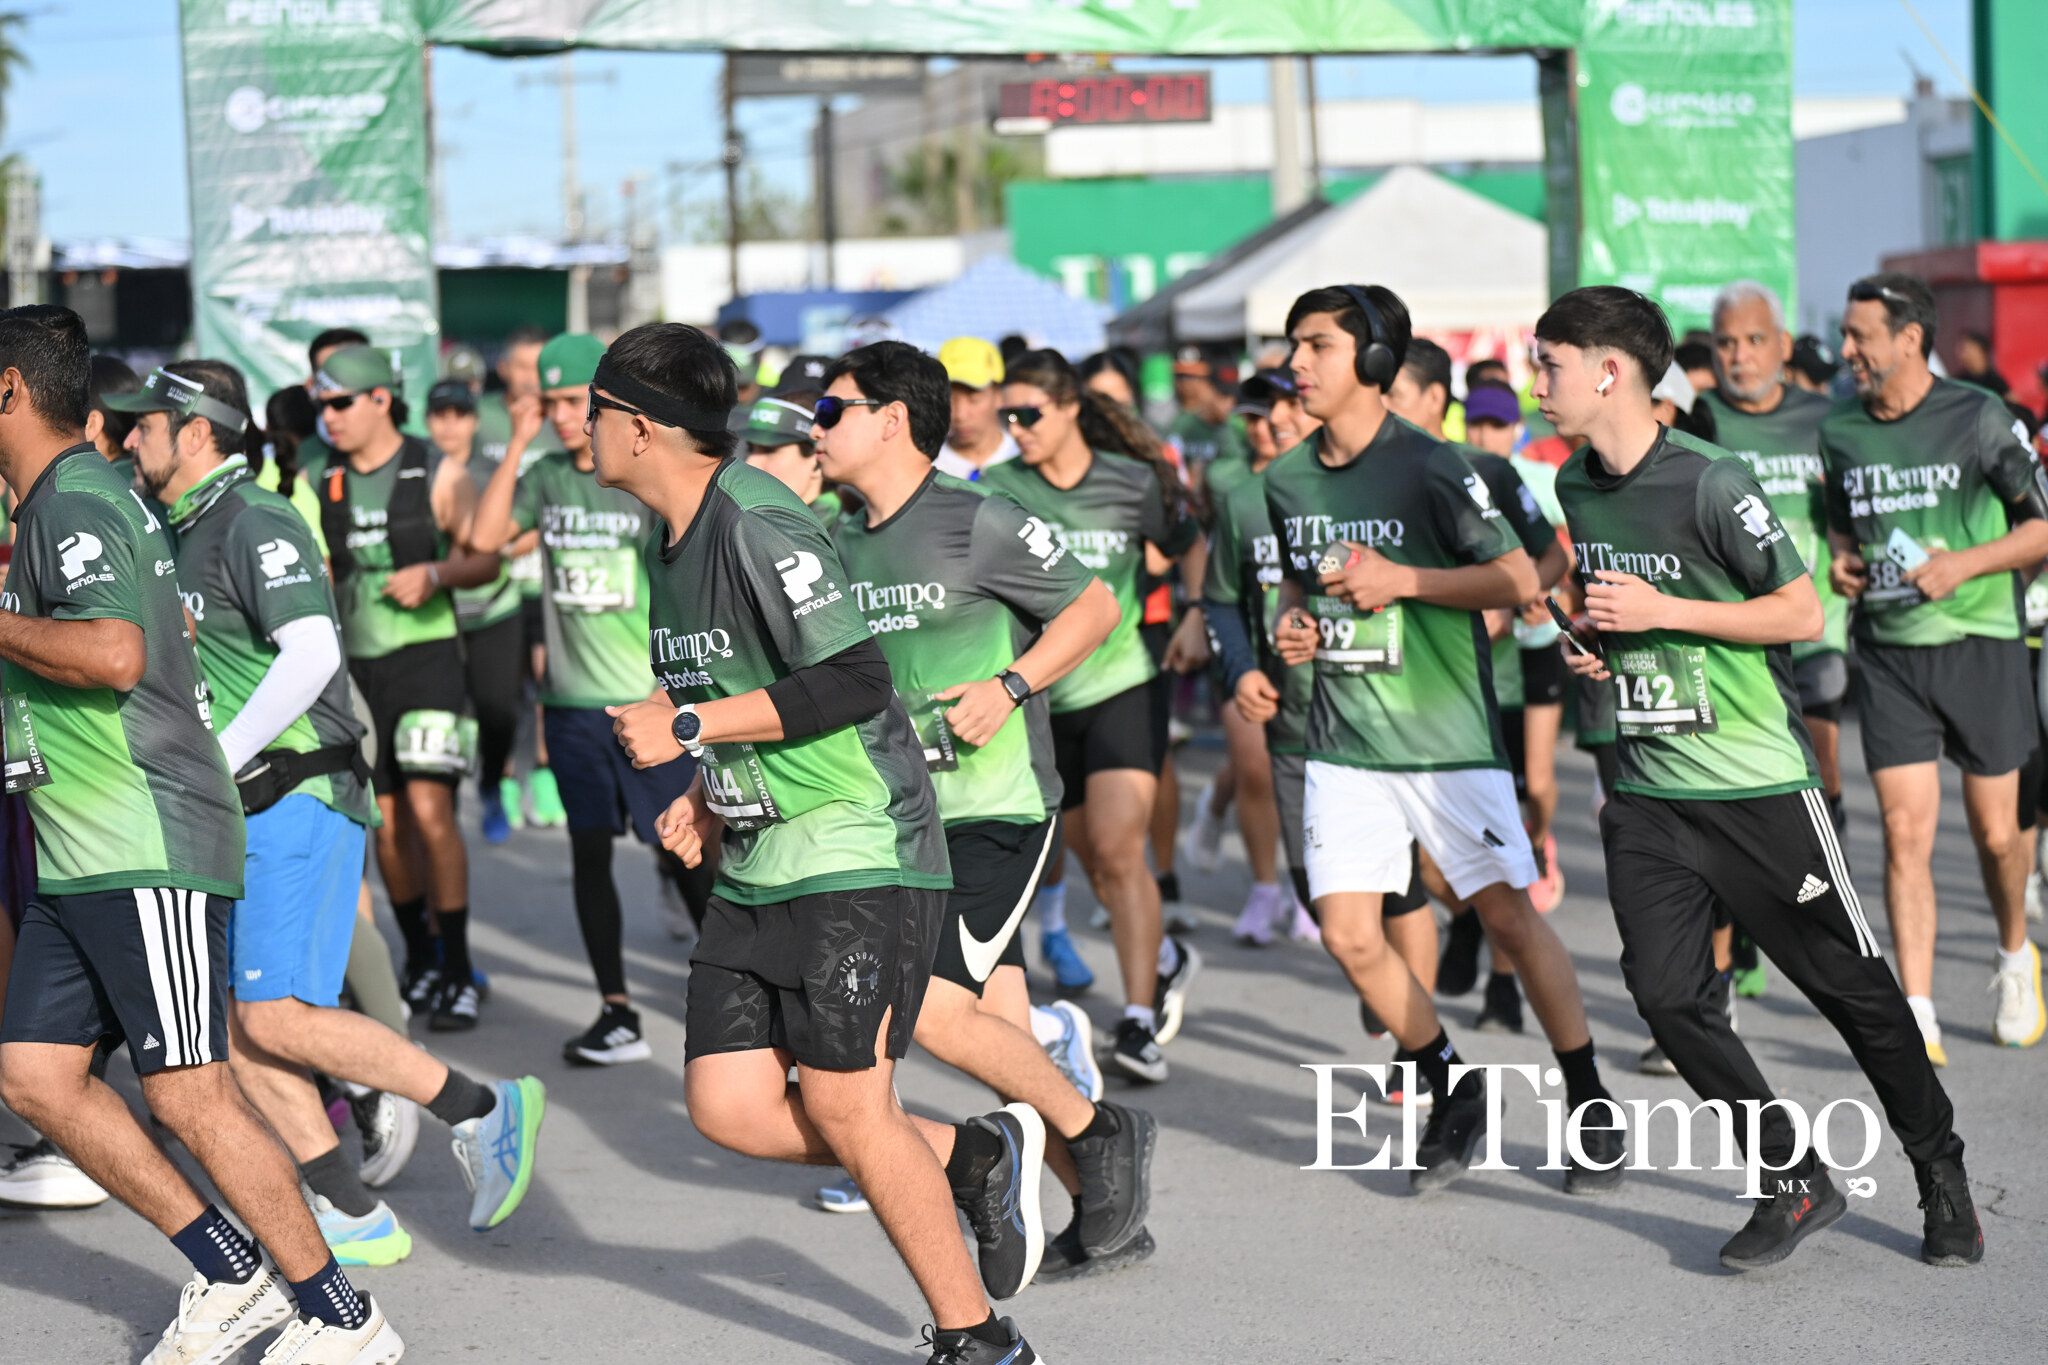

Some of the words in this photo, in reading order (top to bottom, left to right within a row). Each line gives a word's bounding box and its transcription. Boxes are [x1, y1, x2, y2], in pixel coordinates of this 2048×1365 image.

[1844, 466, 1865, 496] El
[1865, 463, 1962, 493] Tiempo
[1872, 491, 1939, 516] todos
[560, 505, 641, 537] Tiempo
[1283, 516, 1303, 548] El
[1305, 515, 1405, 548] Tiempo
[1252, 534, 1280, 565] El
[1591, 543, 1681, 582] Tiempo
[65, 573, 116, 596] PEÑOLES
[555, 566, 608, 594] 132
[792, 590, 844, 620] PEÑOLES
[850, 581, 946, 613] Tiempo
[867, 612, 920, 635] odos
[1319, 617, 1356, 649] 99
[1386, 611, 1399, 666] MEDALLA
[653, 627, 731, 668] Tiempo
[657, 675, 669, 691] e
[664, 667, 714, 690] todos
[1615, 674, 1678, 710] 142
[1692, 668, 1713, 724] MEDALLA
[22, 714, 45, 775] MEDALLA
[741, 744, 753, 752] 144
[932, 706, 955, 762] MEDALLA
[702, 765, 744, 804] 144
[748, 758, 778, 818] MEDALLA
[1796, 880, 1830, 904] adidas
[219, 1313, 240, 1333] ON
